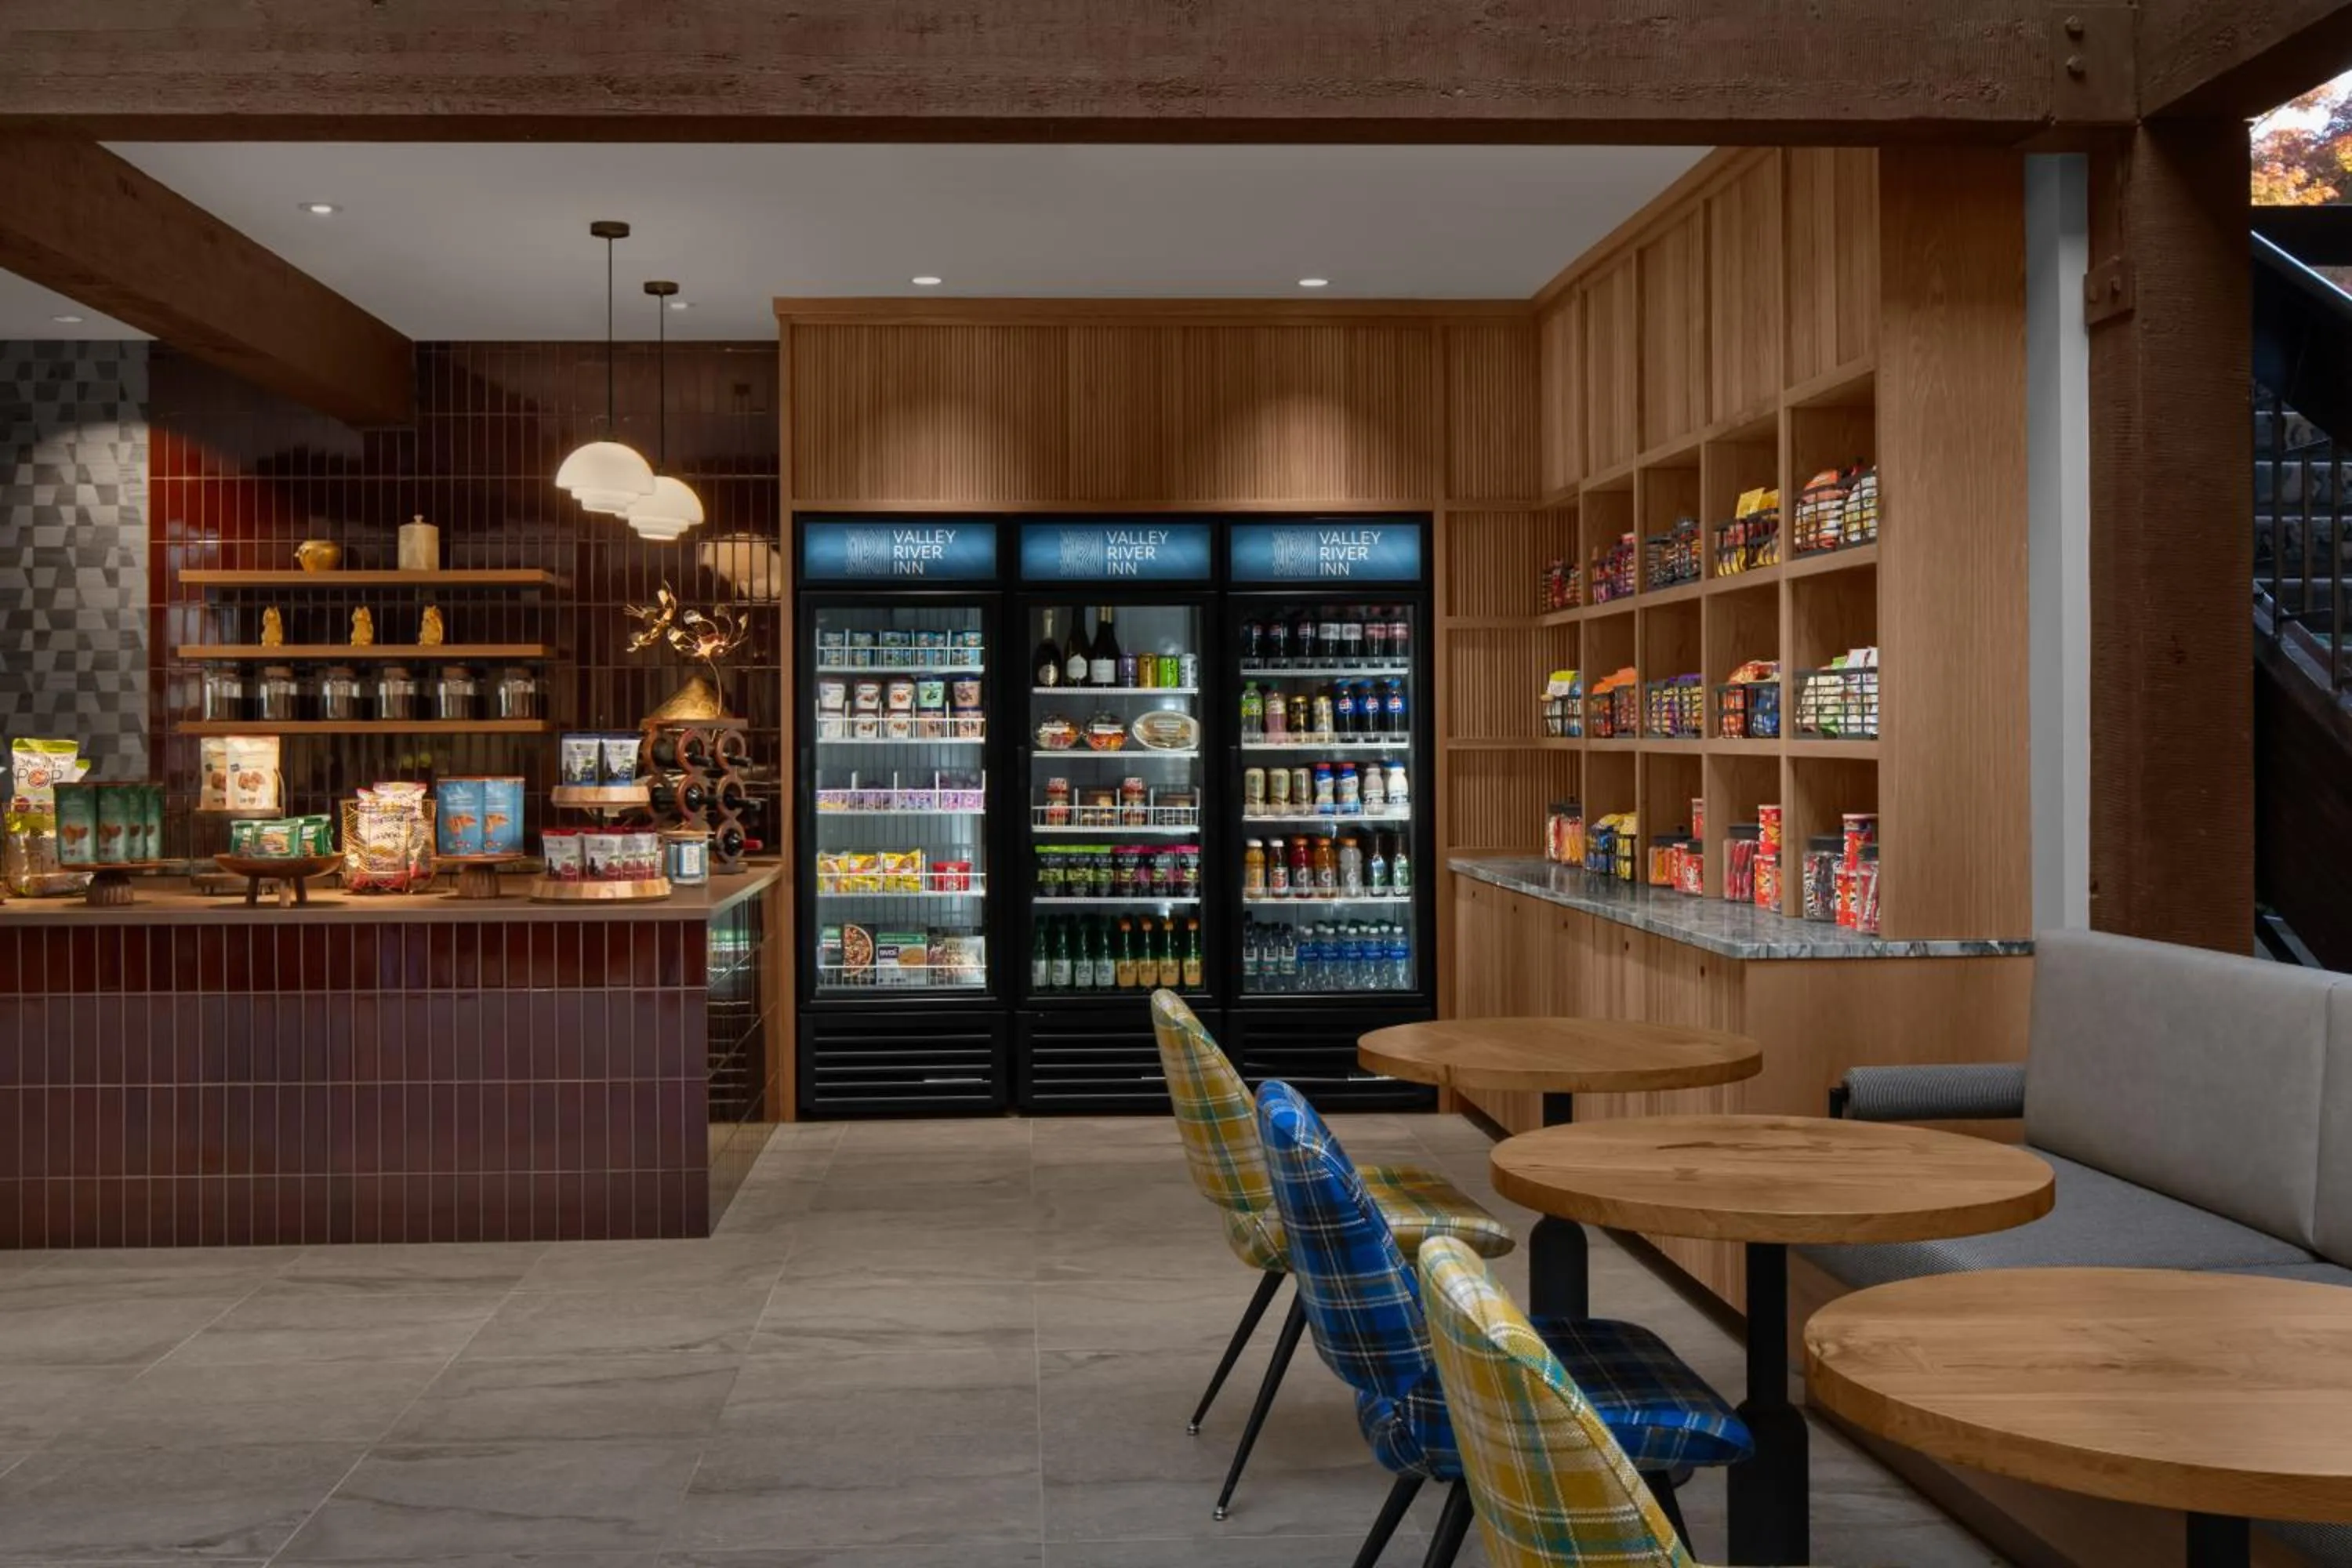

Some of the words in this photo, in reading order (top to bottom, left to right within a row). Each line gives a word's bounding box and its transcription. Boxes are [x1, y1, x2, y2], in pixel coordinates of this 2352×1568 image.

[893, 530, 956, 543] VALLEY
[1106, 531, 1169, 545] VALLEY
[1319, 531, 1381, 545] VALLEY
[894, 546, 943, 559] RIVER
[1108, 546, 1156, 560] RIVER
[1319, 546, 1368, 561] RIVER
[894, 561, 924, 575] INN
[1108, 561, 1138, 575] INN
[1319, 561, 1350, 576] INN
